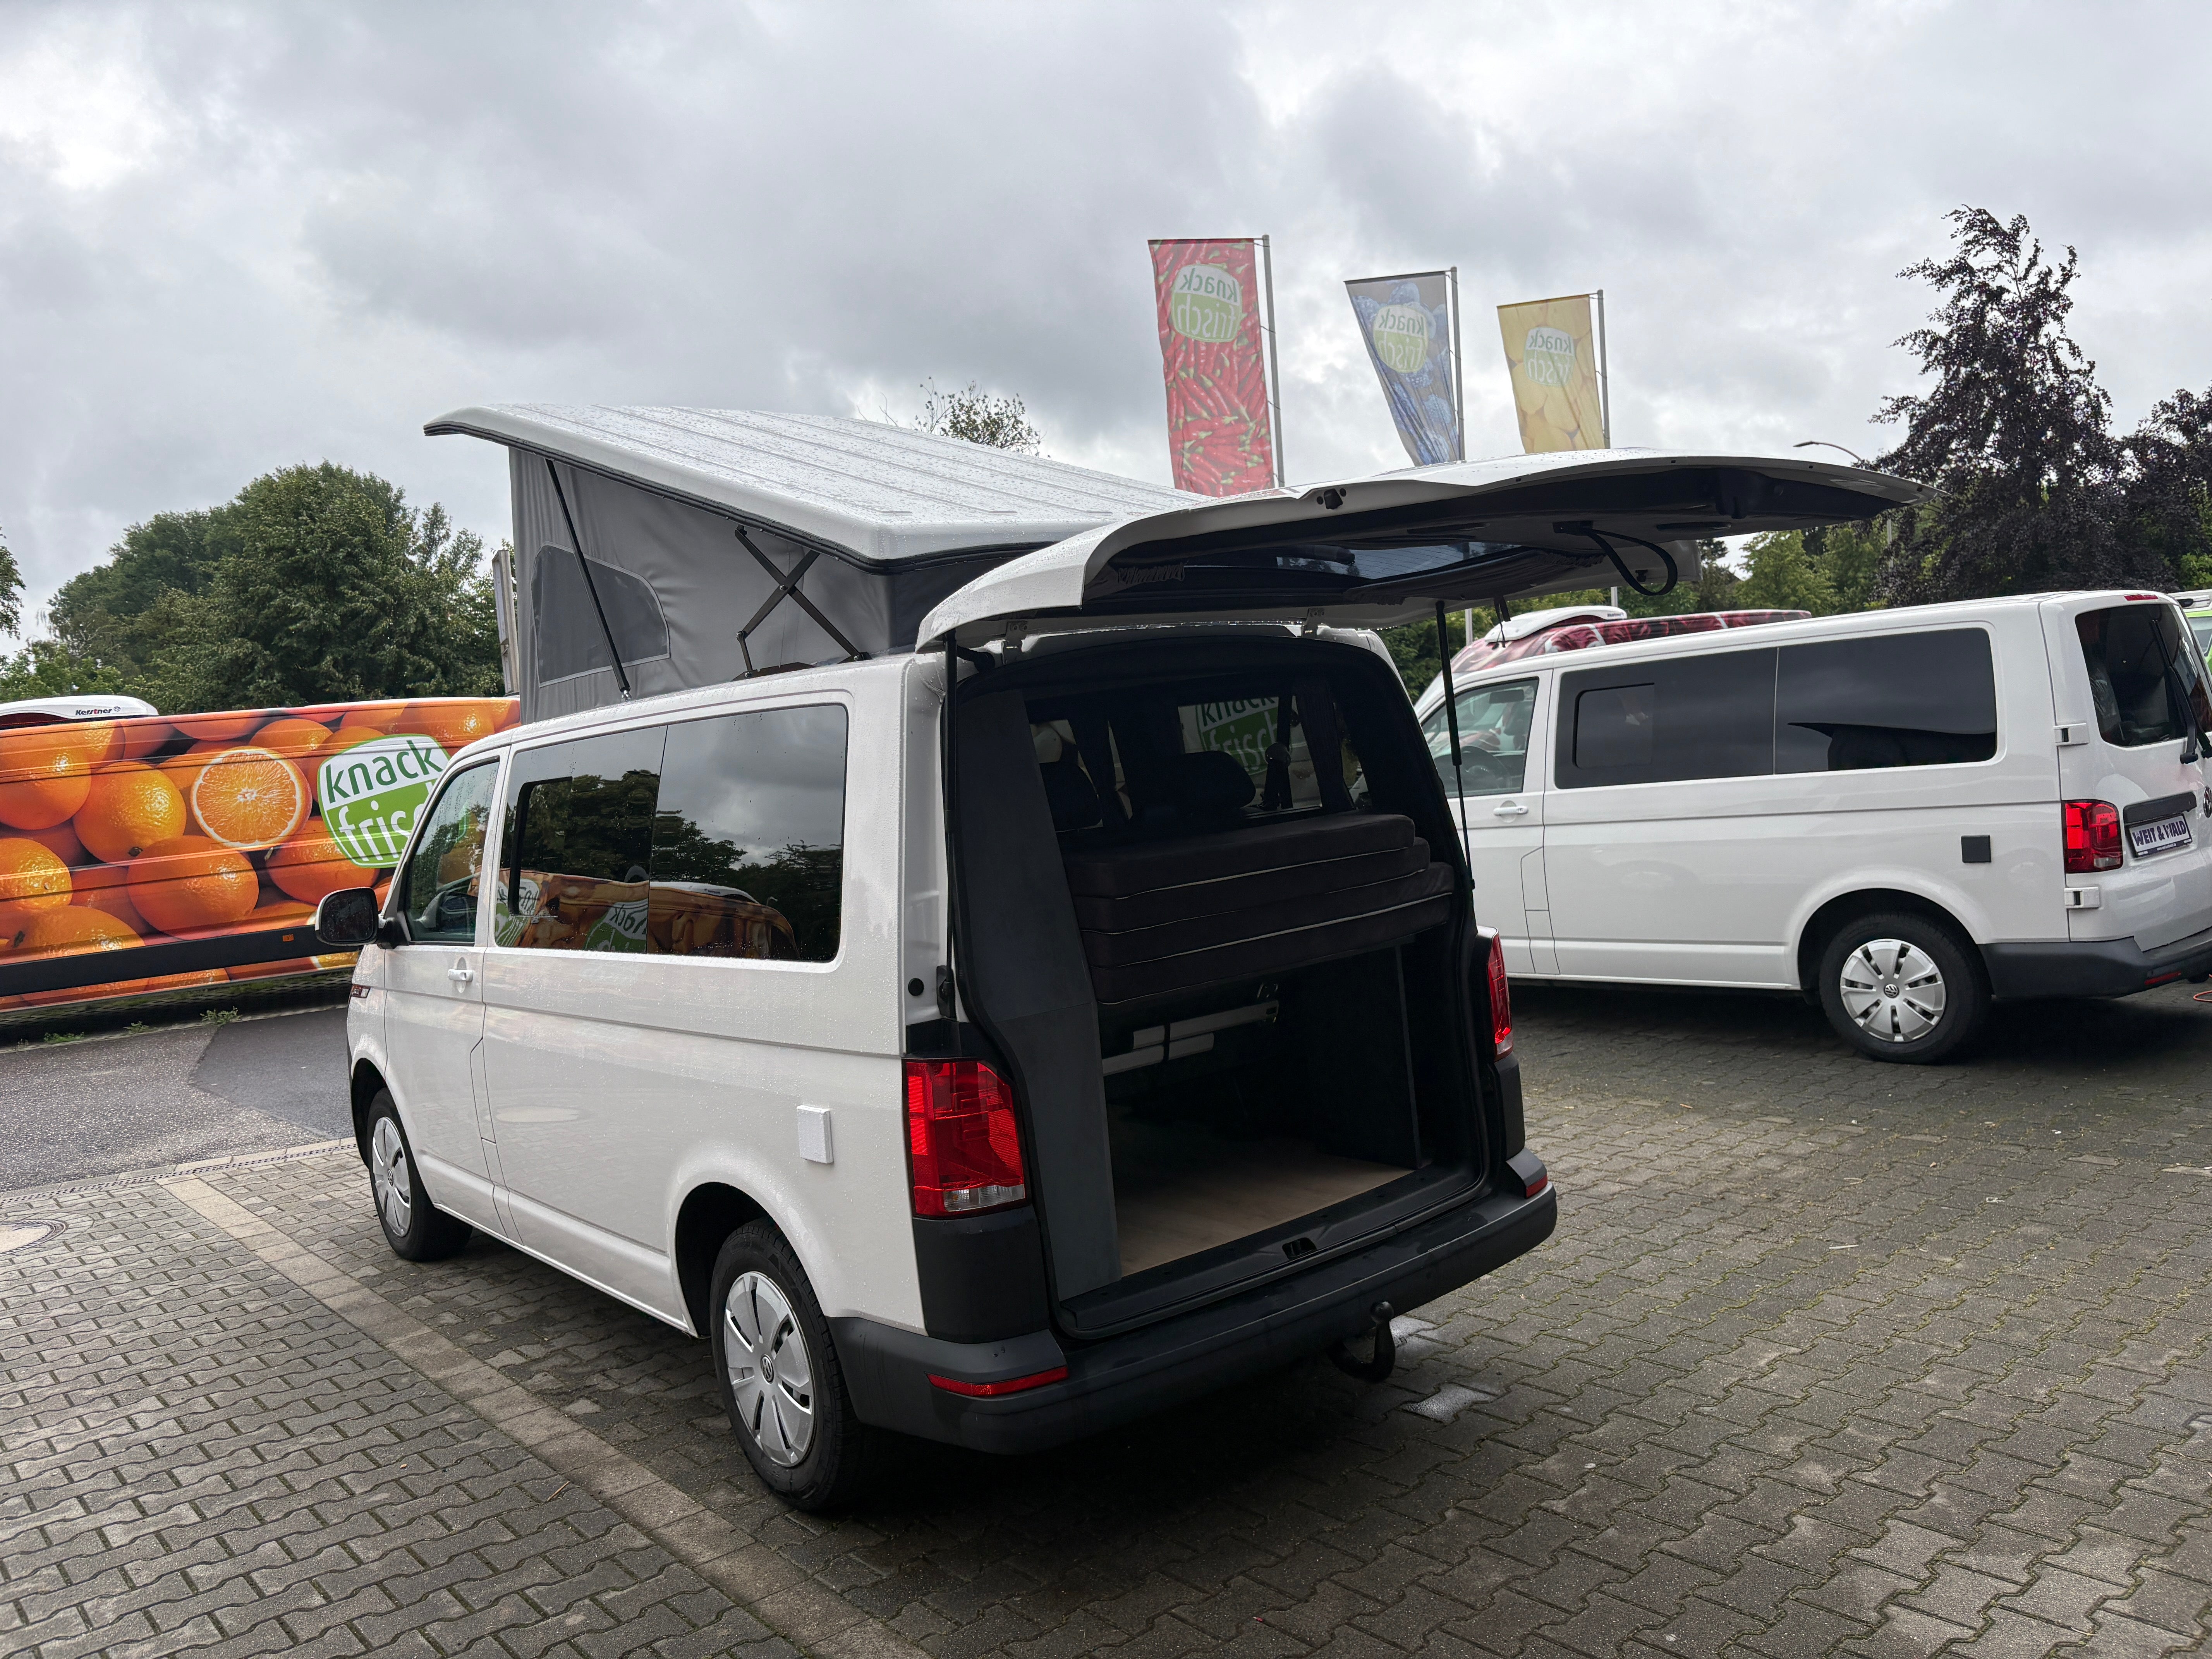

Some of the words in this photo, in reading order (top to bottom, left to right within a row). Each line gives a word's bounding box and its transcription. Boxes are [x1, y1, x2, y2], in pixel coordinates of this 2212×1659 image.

[1201, 697, 1275, 726] kna
[326, 740, 443, 804] knack
[338, 781, 434, 862] fris
[2132, 828, 2157, 846] WEIT
[2157, 826, 2166, 841] &
[2162, 820, 2186, 838] WALD
